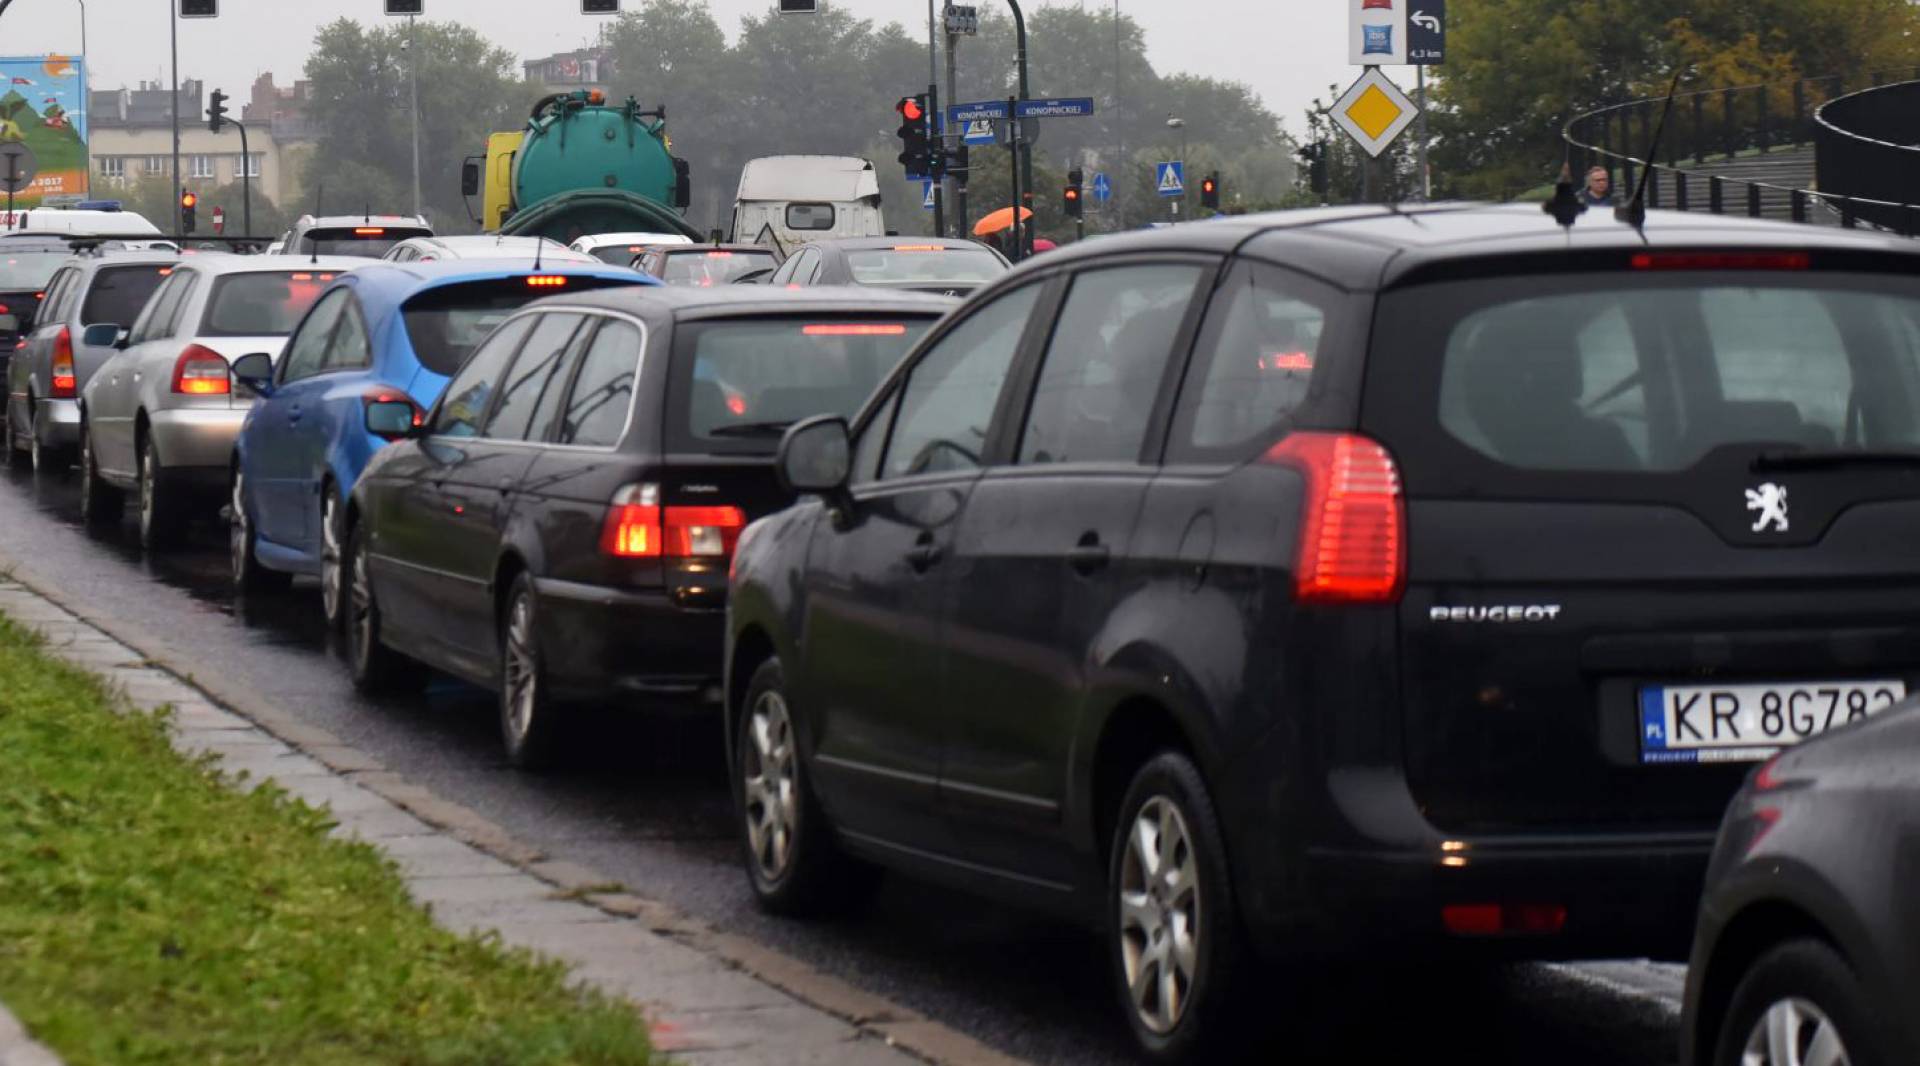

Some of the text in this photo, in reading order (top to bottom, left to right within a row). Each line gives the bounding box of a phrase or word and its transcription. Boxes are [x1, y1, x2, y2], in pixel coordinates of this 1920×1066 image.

[1427, 49, 1441, 58] km
[957, 109, 1002, 120] KONOPNICKIEJ
[1025, 105, 1082, 116] KONOPNICKIEJ
[1429, 604, 1561, 622] PEUGEOT
[1673, 691, 1741, 741] KR
[1646, 724, 1664, 740] PL
